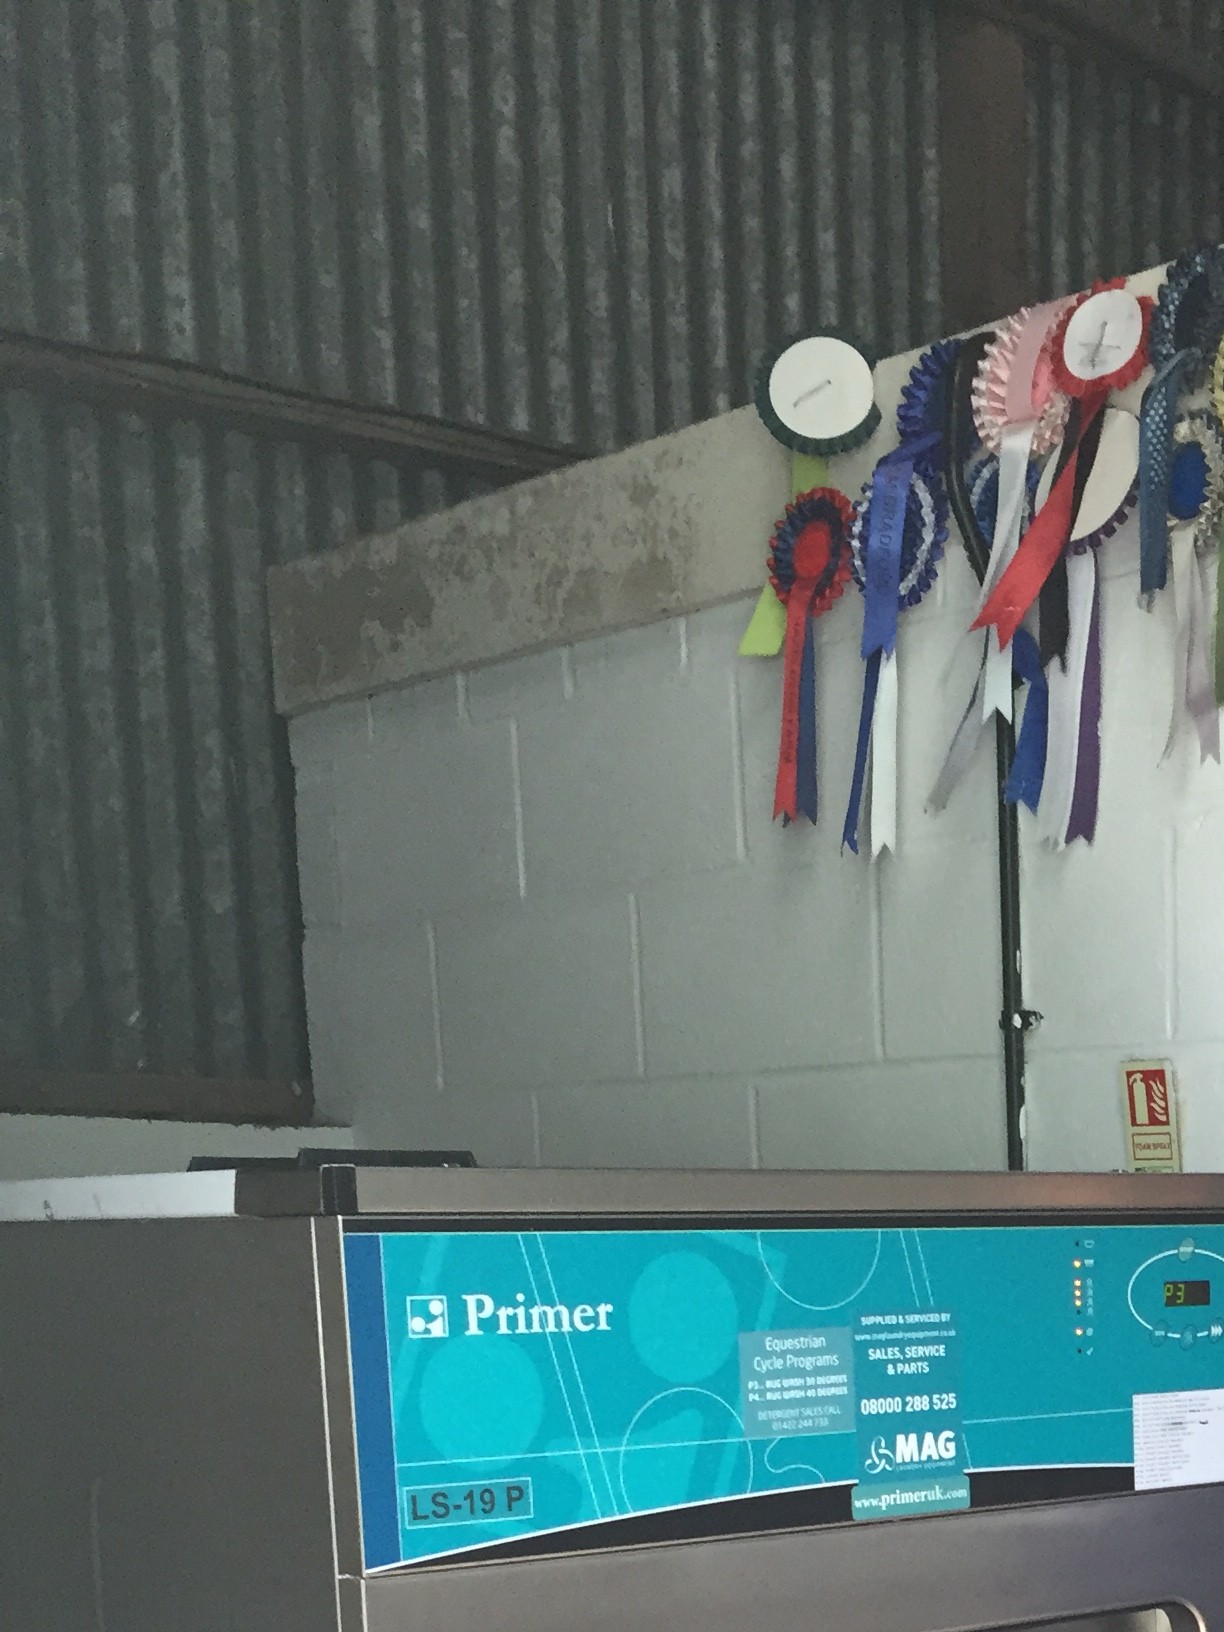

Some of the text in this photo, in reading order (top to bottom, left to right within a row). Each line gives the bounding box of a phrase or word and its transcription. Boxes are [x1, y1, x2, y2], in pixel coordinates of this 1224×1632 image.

[461, 1293, 614, 1336] Primer
[861, 1315, 897, 1326] SUPPLIED
[905, 1313, 940, 1324] SERVICED
[940, 1313, 951, 1322] BY
[765, 1336, 826, 1352] Equestrian
[868, 1345, 946, 1360] SALES, SERVICE
[754, 1354, 840, 1373] Cycle Programs
[887, 1361, 930, 1375] & PARTS
[861, 1393, 957, 1416] 08000 288 525
[896, 1430, 956, 1463] MAG
[410, 1486, 525, 1521] LS-19 P
[854, 1485, 967, 1510] www.primeruk.com
